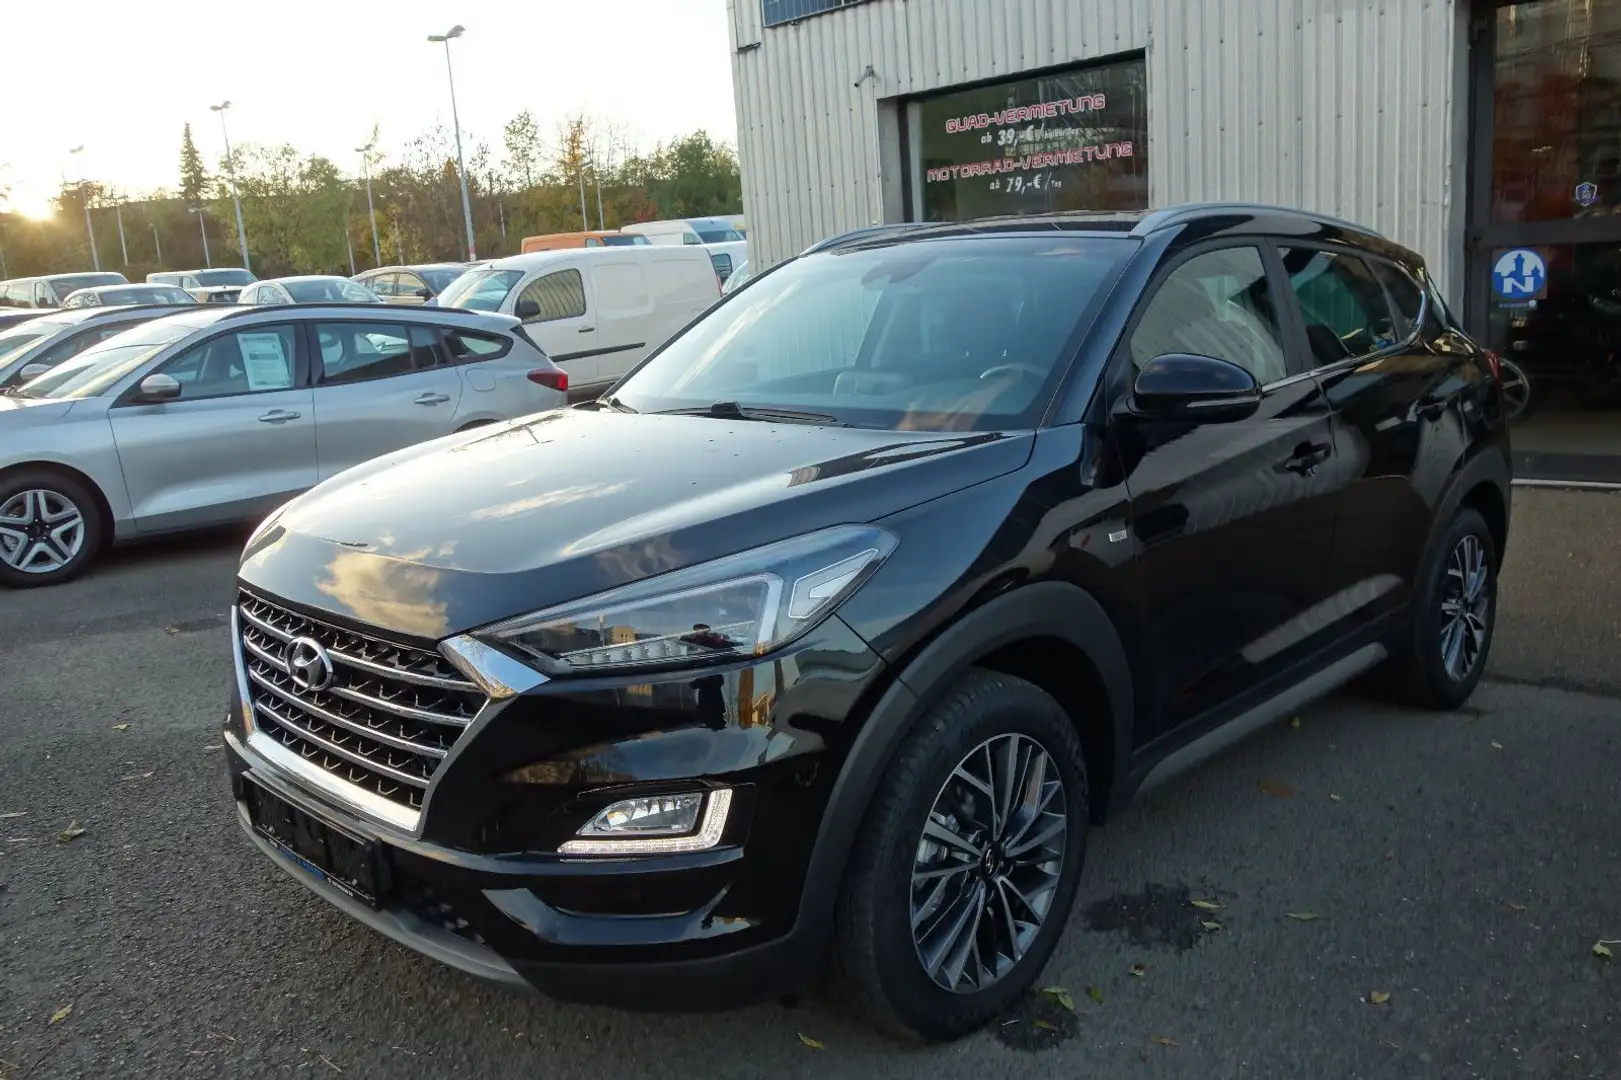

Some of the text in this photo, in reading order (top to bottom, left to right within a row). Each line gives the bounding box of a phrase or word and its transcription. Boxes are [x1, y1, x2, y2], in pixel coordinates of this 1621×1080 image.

[946, 94, 1106, 133] QUAD-VERMIETUNG
[980, 132, 992, 144] ab
[927, 141, 1133, 183] MOTORRAD-VERMIETUNG
[989, 181, 1001, 191] ab
